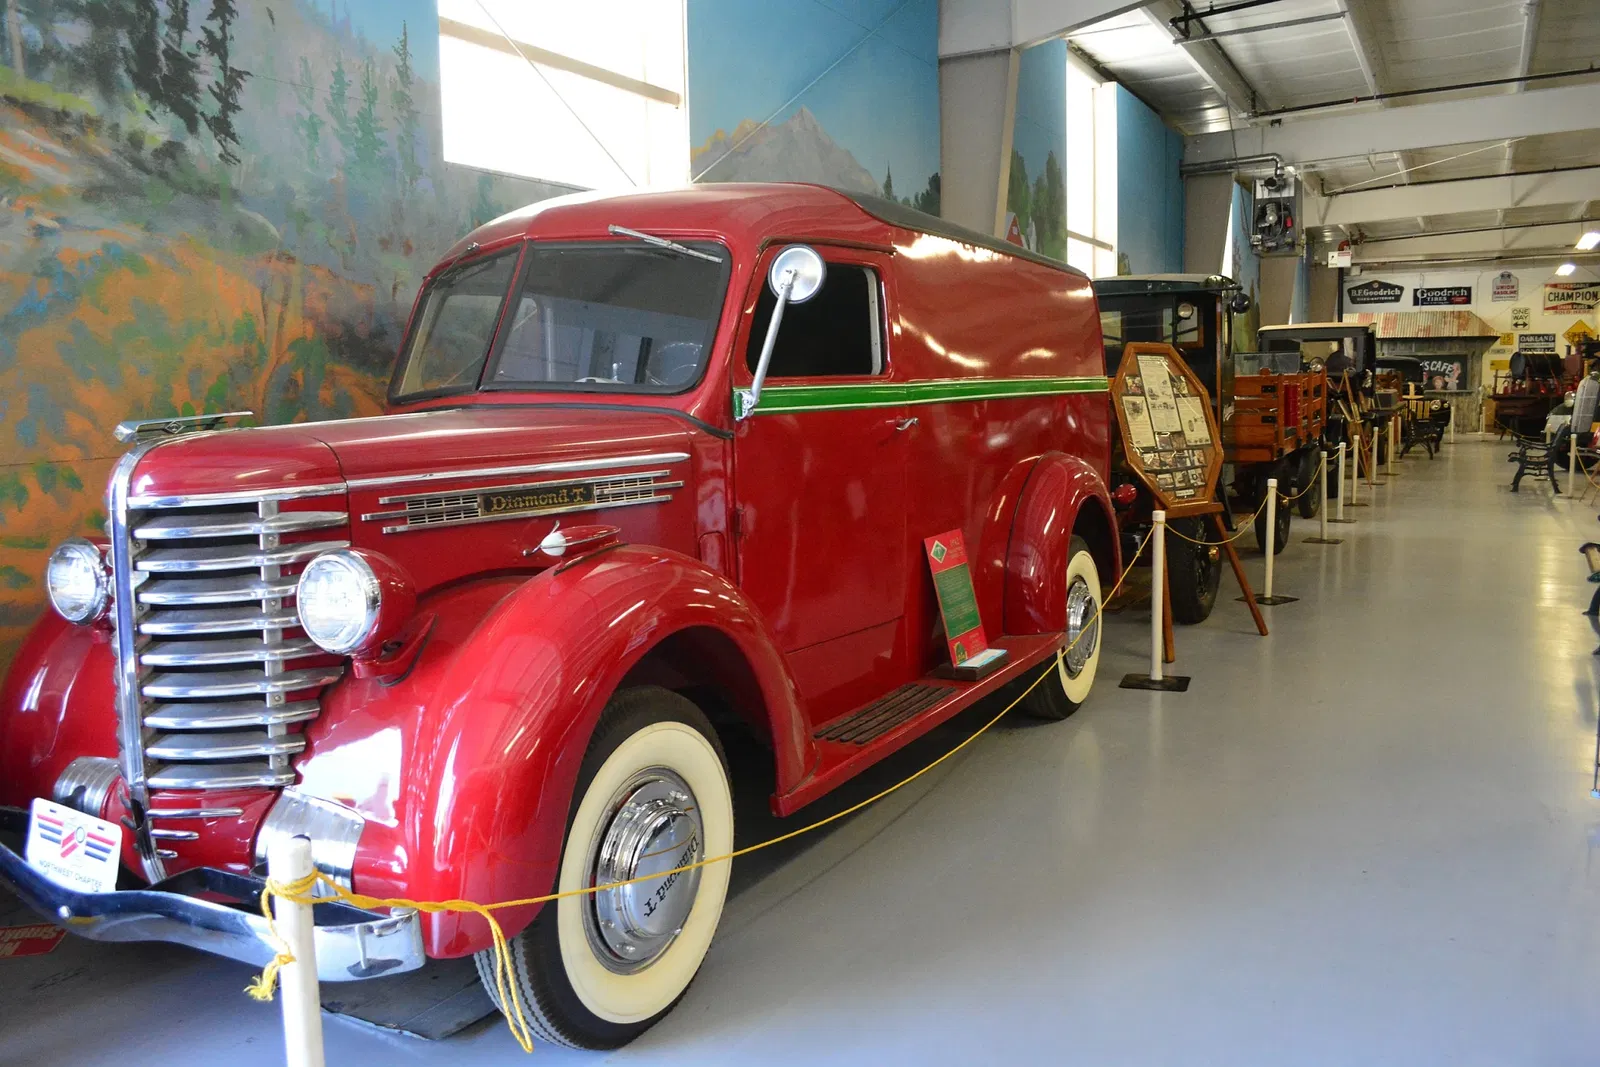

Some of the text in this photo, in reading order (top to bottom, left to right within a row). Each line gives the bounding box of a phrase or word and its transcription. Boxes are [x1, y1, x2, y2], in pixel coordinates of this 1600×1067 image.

[1416, 288, 1467, 298] Goodrich
[1547, 291, 1599, 302] CHAMPION
[1430, 360, 1453, 376] CAFE
[490, 487, 586, 511] Diamond T
[38, 859, 103, 888] NORTHWEST CHAPTER
[644, 836, 700, 917] Diamond T
